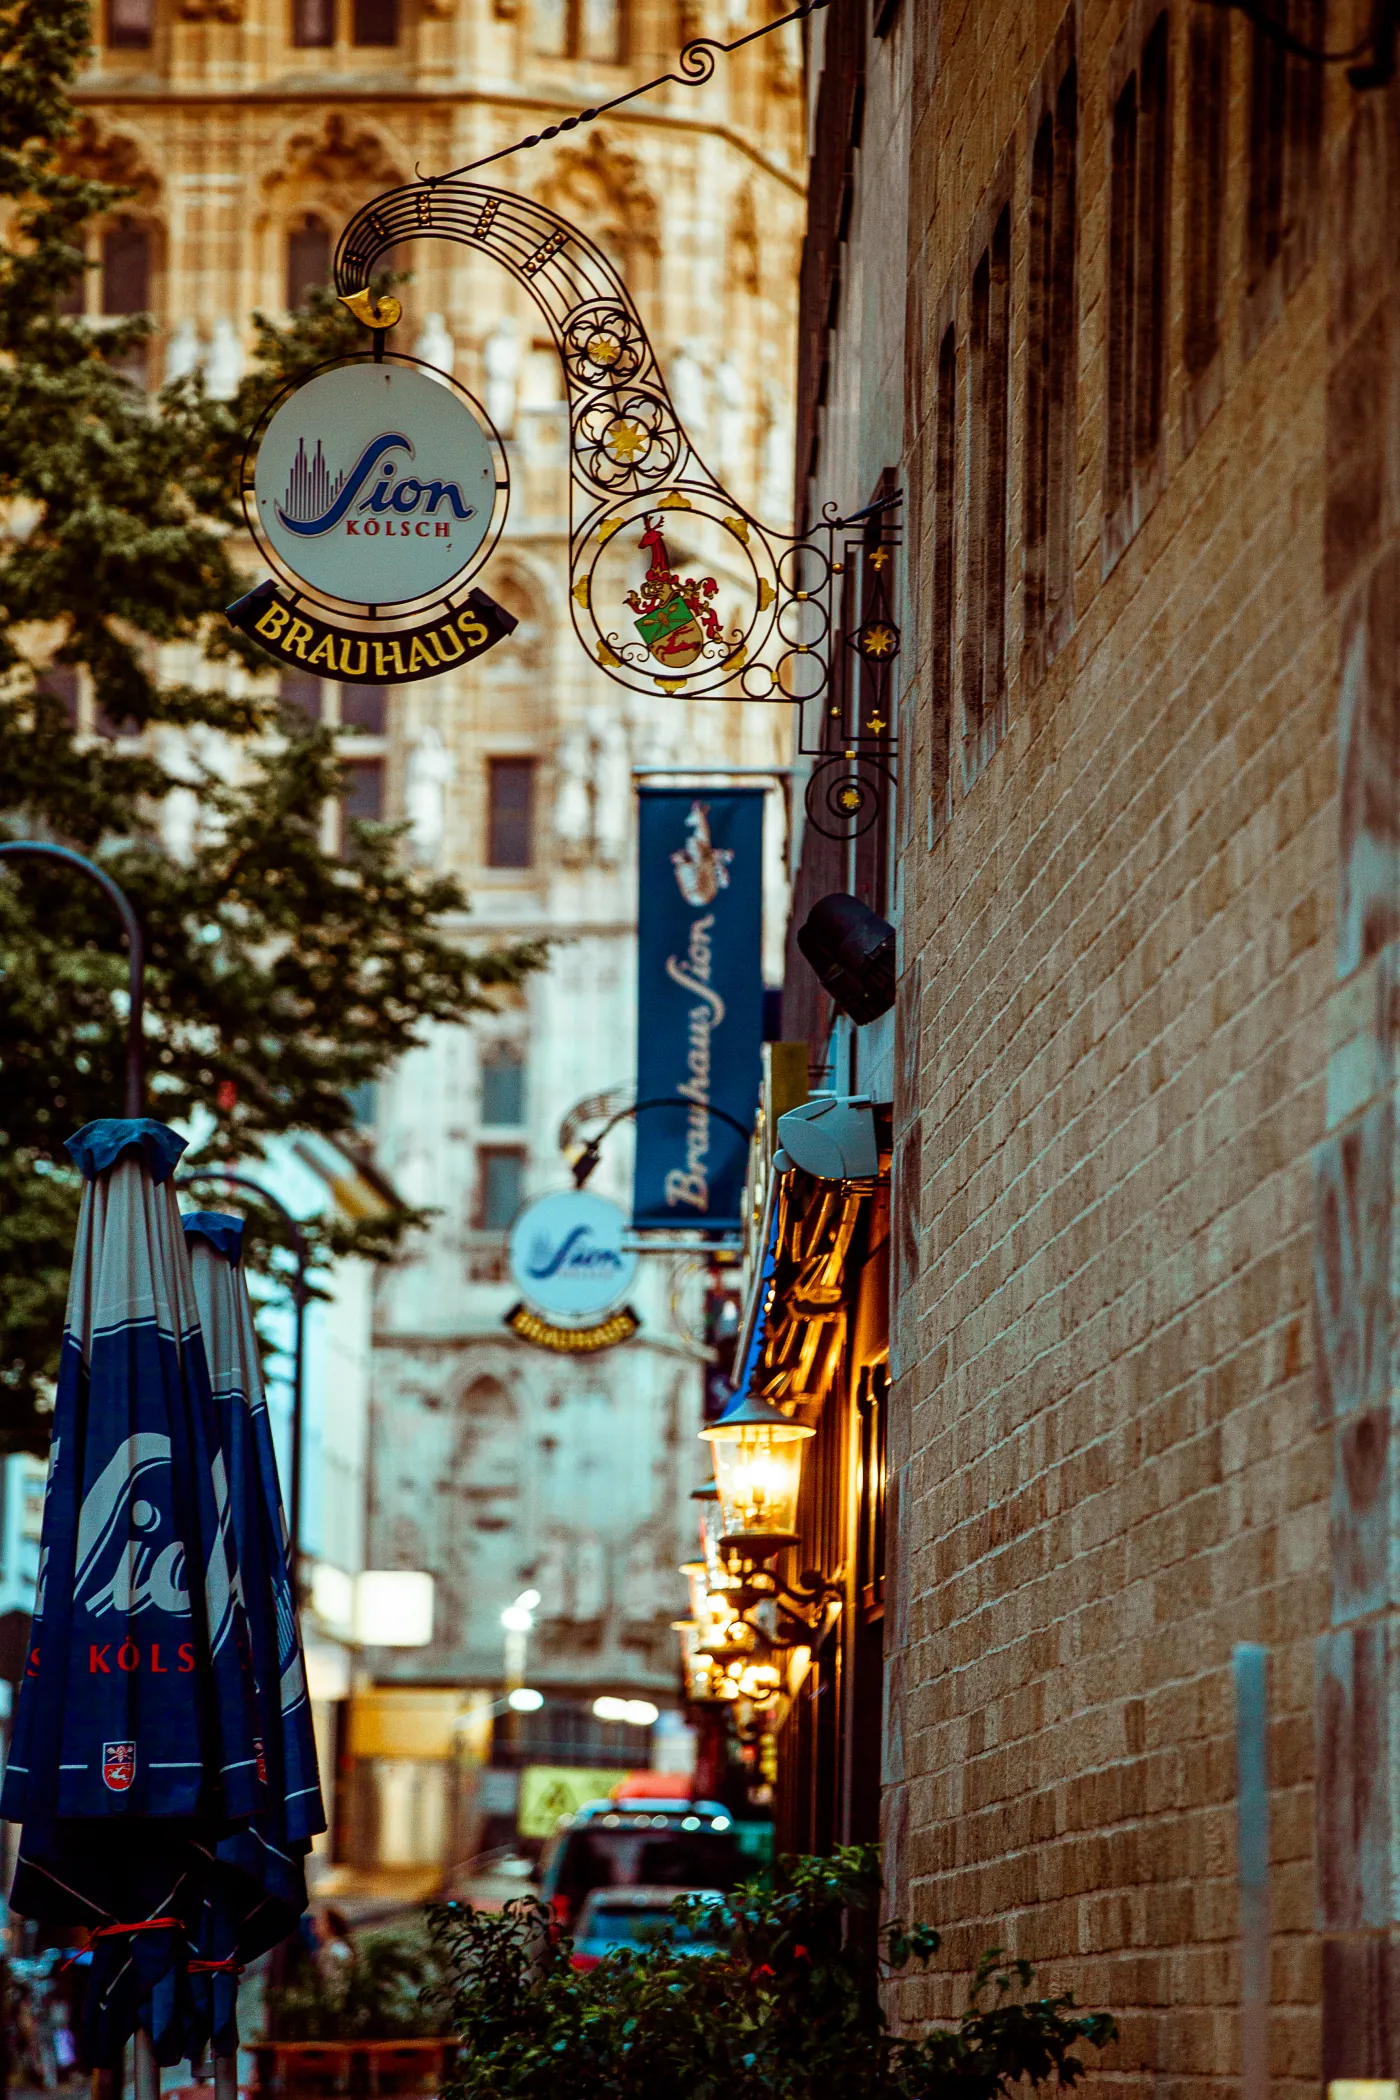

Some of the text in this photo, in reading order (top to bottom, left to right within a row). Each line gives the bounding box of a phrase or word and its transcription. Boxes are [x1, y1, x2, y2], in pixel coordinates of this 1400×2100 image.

[274, 431, 478, 538] Sion
[345, 517, 450, 537] KÖLSCH
[254, 600, 489, 676] BRAUHAUS
[664, 913, 725, 1212] Brauhaus Sion
[89, 1636, 195, 1673] KÖLS
